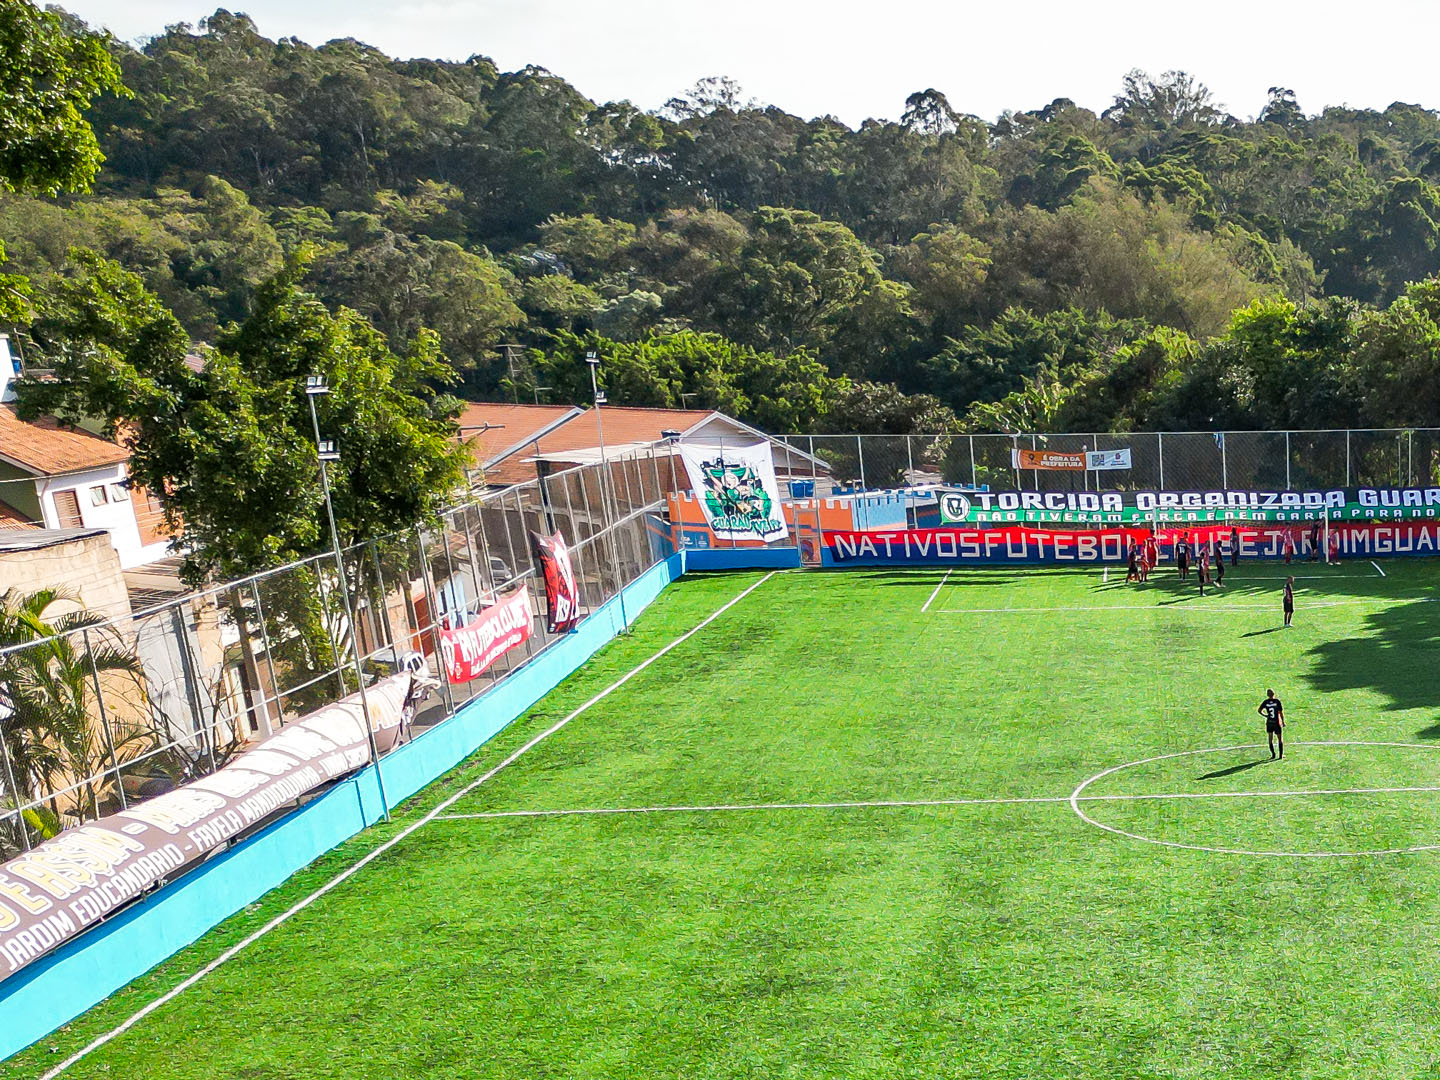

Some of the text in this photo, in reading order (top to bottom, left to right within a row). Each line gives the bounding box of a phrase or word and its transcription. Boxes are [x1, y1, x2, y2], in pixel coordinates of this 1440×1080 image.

[974, 493, 1124, 511] TORCIDA
[1136, 490, 1346, 511] ORGANIZADA
[1026, 511, 1122, 522] TIVERAM
[1206, 512, 1216, 521] E
[1224, 510, 1267, 521] NEM
[1276, 509, 1342, 521] GARRA
[1351, 508, 1403, 518] PARA
[1268, 707, 1275, 719] 3
[4, 909, 76, 972] JARDIM
[187, 809, 243, 852] FAVELA
[236, 766, 321, 825] MANDIOQUINHA
